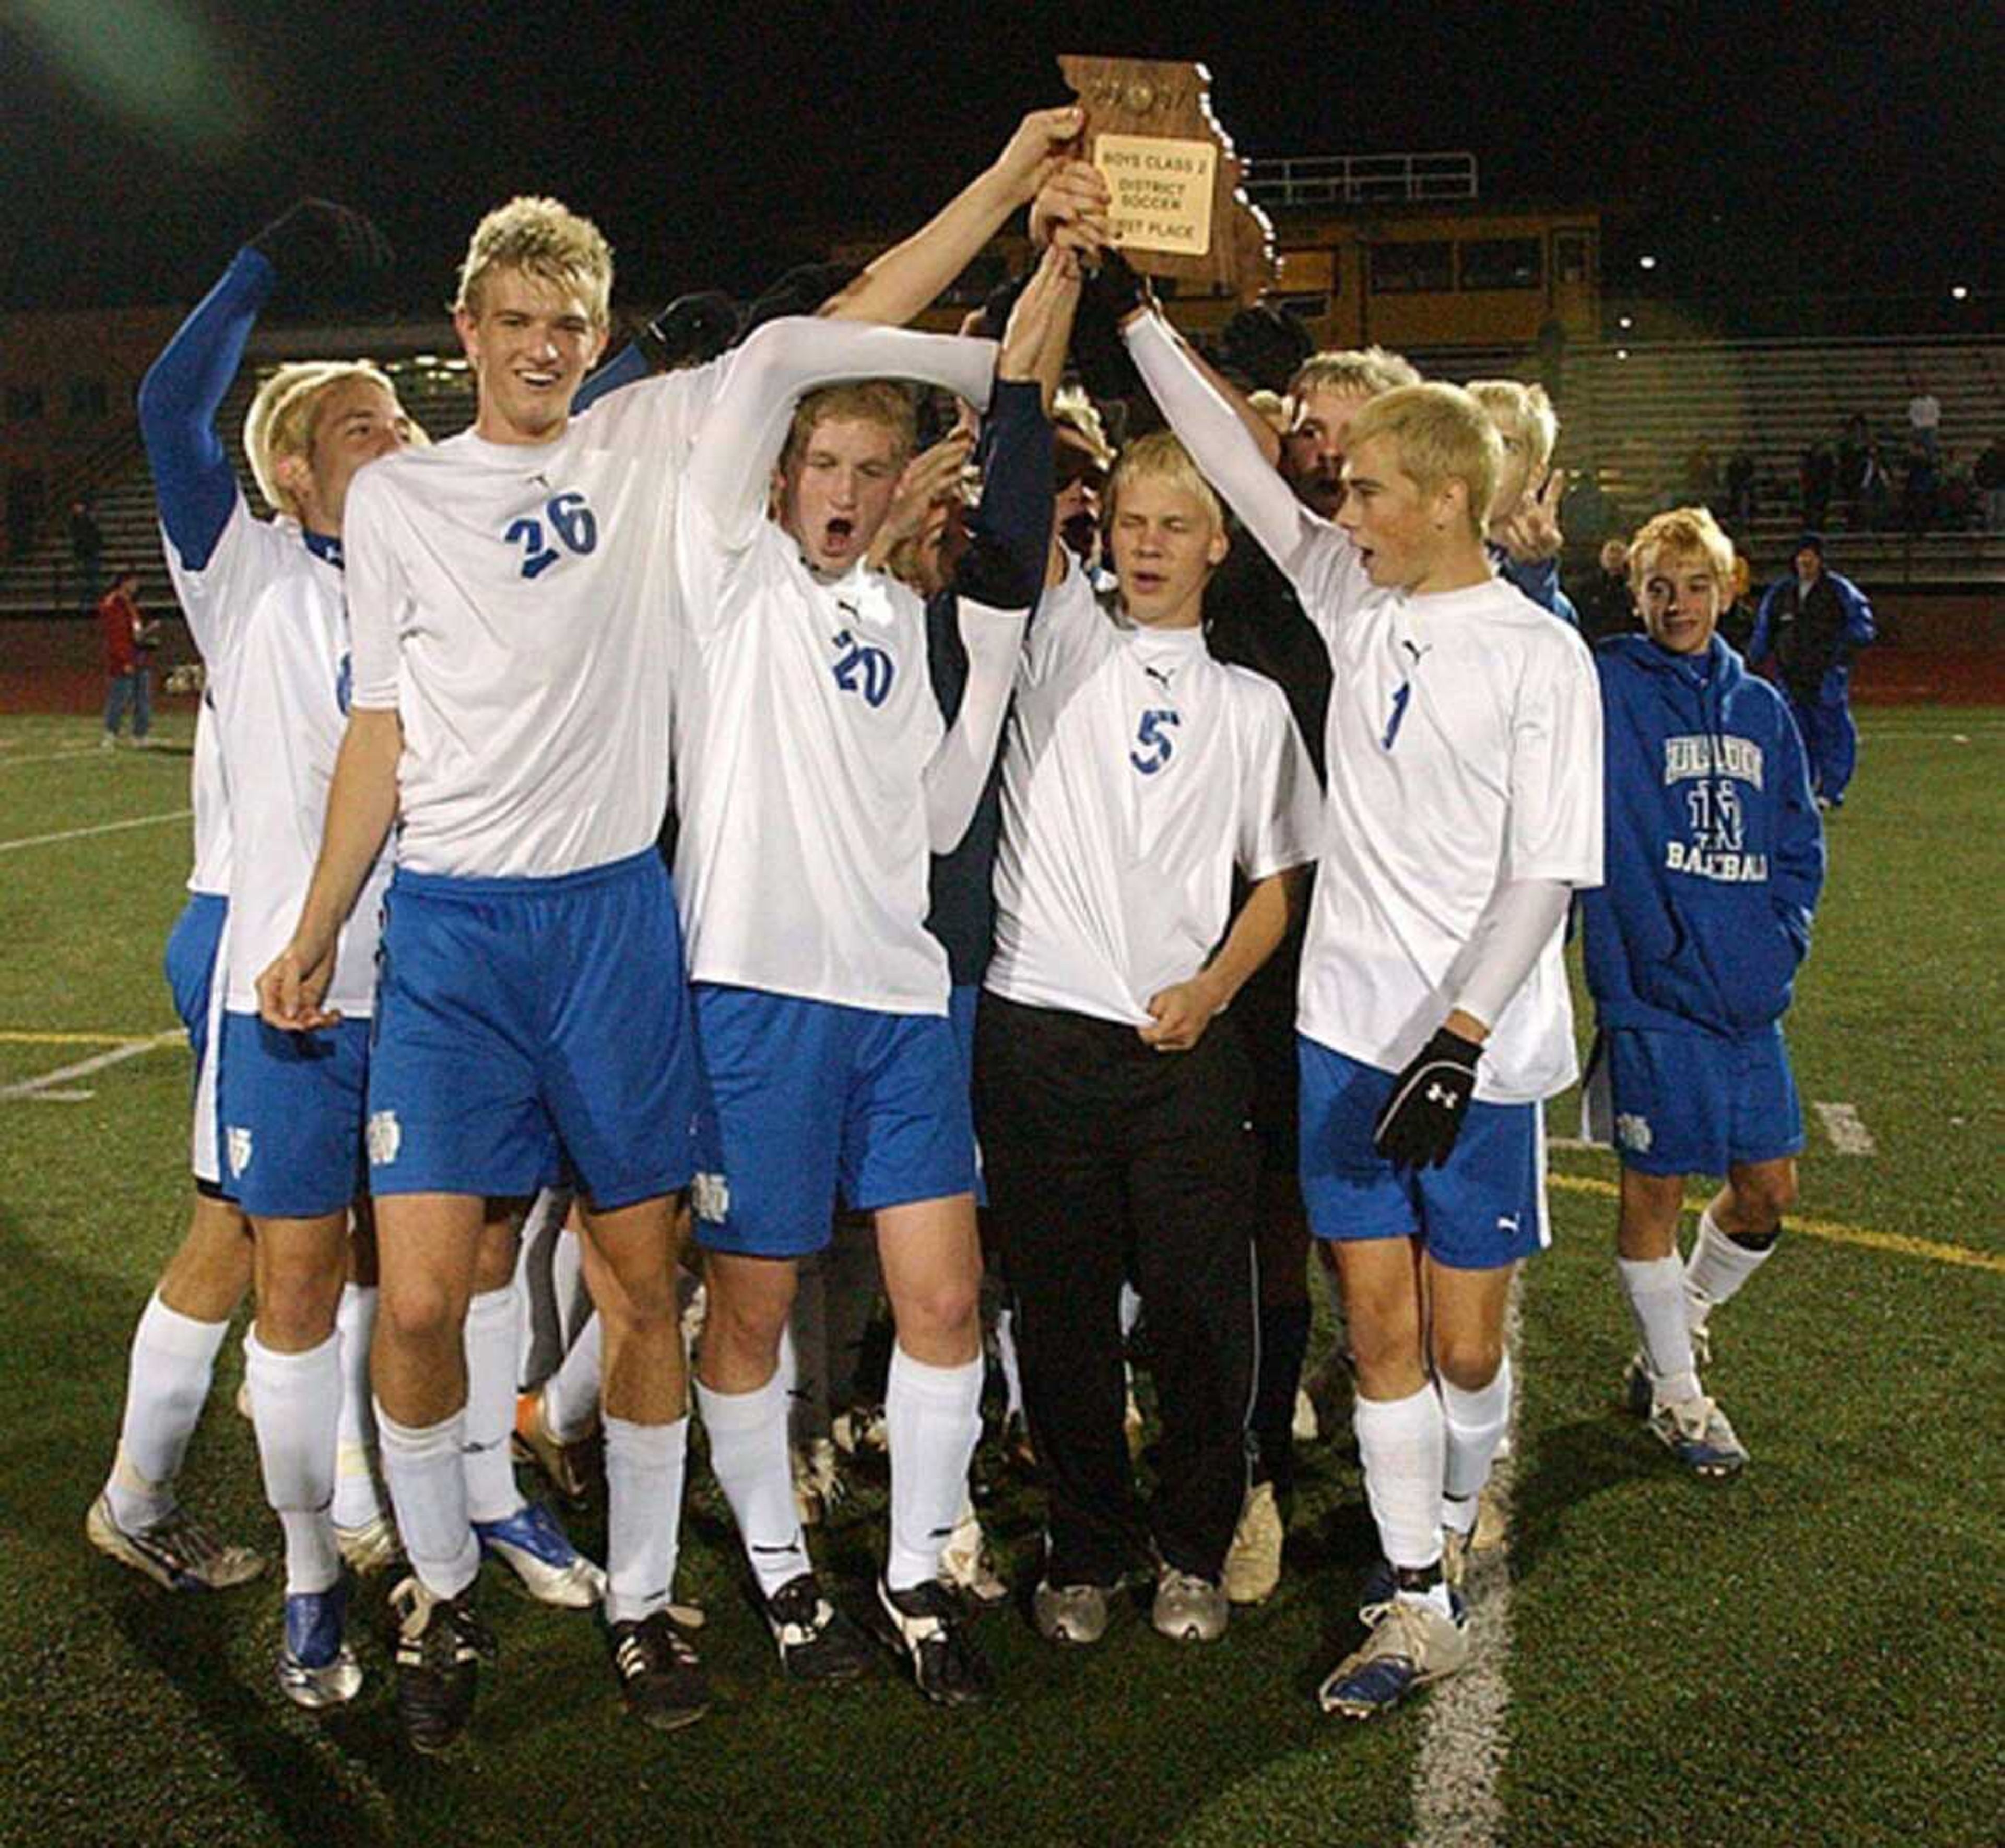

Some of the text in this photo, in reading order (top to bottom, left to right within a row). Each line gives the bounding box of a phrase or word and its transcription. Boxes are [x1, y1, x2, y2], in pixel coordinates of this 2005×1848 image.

[1103, 151, 1140, 169] BOYS
[1145, 155, 1193, 174] CLASS
[1118, 176, 1186, 195] DISTRICT
[1121, 193, 1182, 212] SOCCER
[1148, 222, 1195, 239] PLACE
[503, 492, 597, 579] 26
[831, 629, 895, 708] 20
[1381, 680, 1411, 750] 1
[1129, 710, 1181, 775] 5
